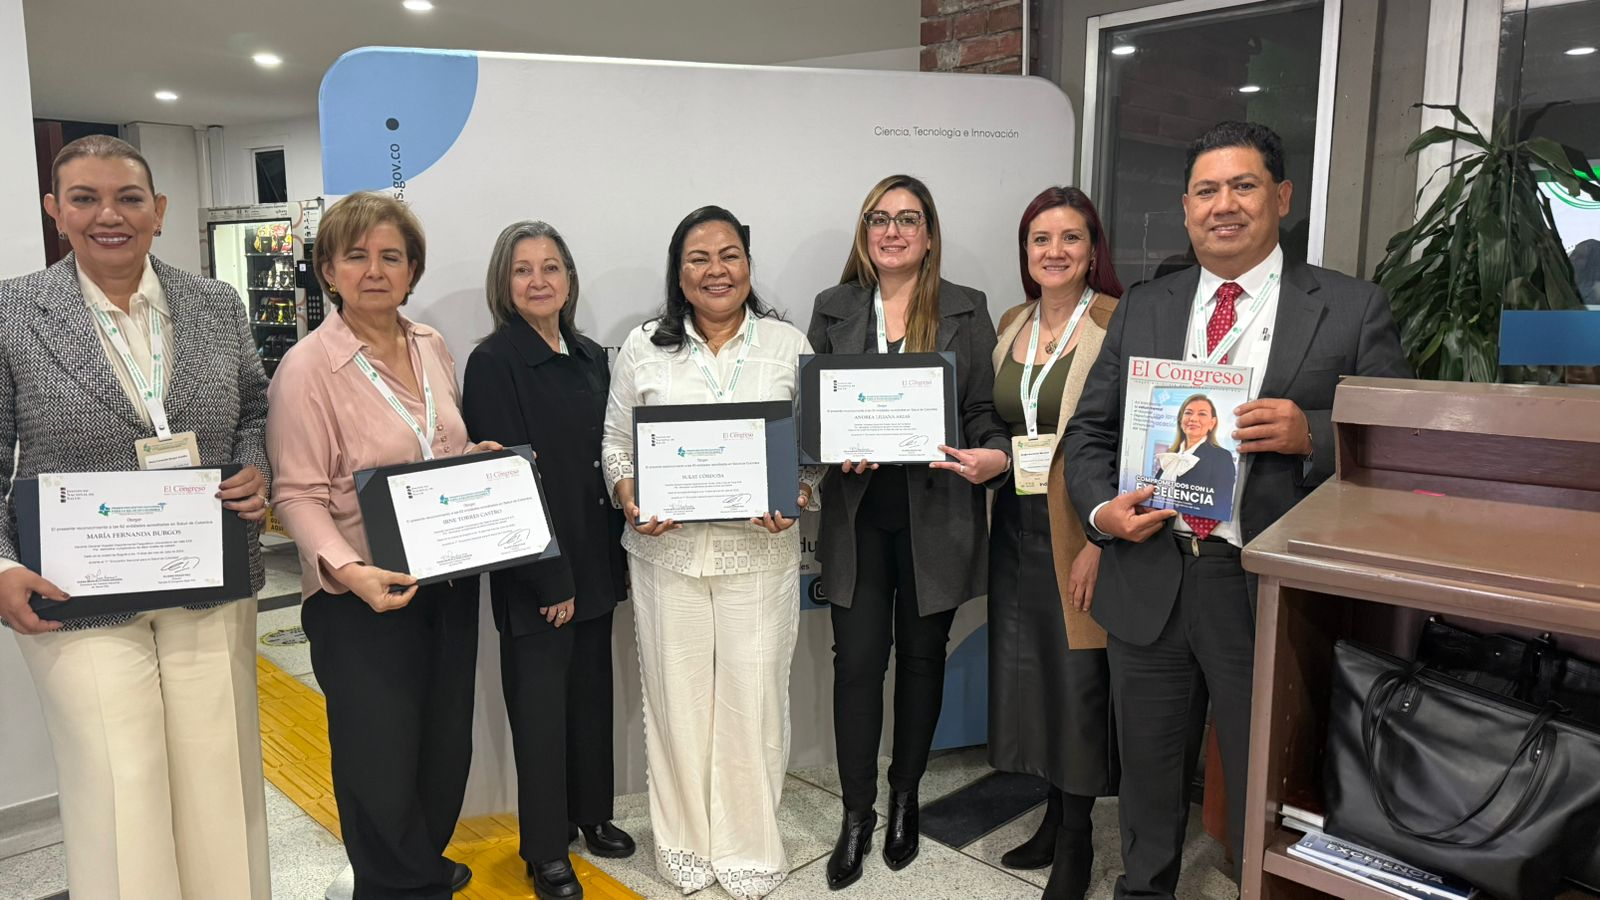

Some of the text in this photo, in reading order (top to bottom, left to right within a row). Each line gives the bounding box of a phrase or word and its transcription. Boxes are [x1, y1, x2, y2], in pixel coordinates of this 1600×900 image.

[874, 125, 911, 137] Ciencia,
[912, 126, 961, 139] Tecnología
[971, 128, 1019, 138] Innovación
[390, 143, 406, 202] s.gov.co
[1132, 360, 1244, 386] El Congreso
[1136, 475, 1189, 490] COMPROMETIDOS
[87, 532, 110, 540] MARÍA
[1326, 843, 1444, 884] EXCELENCIA
